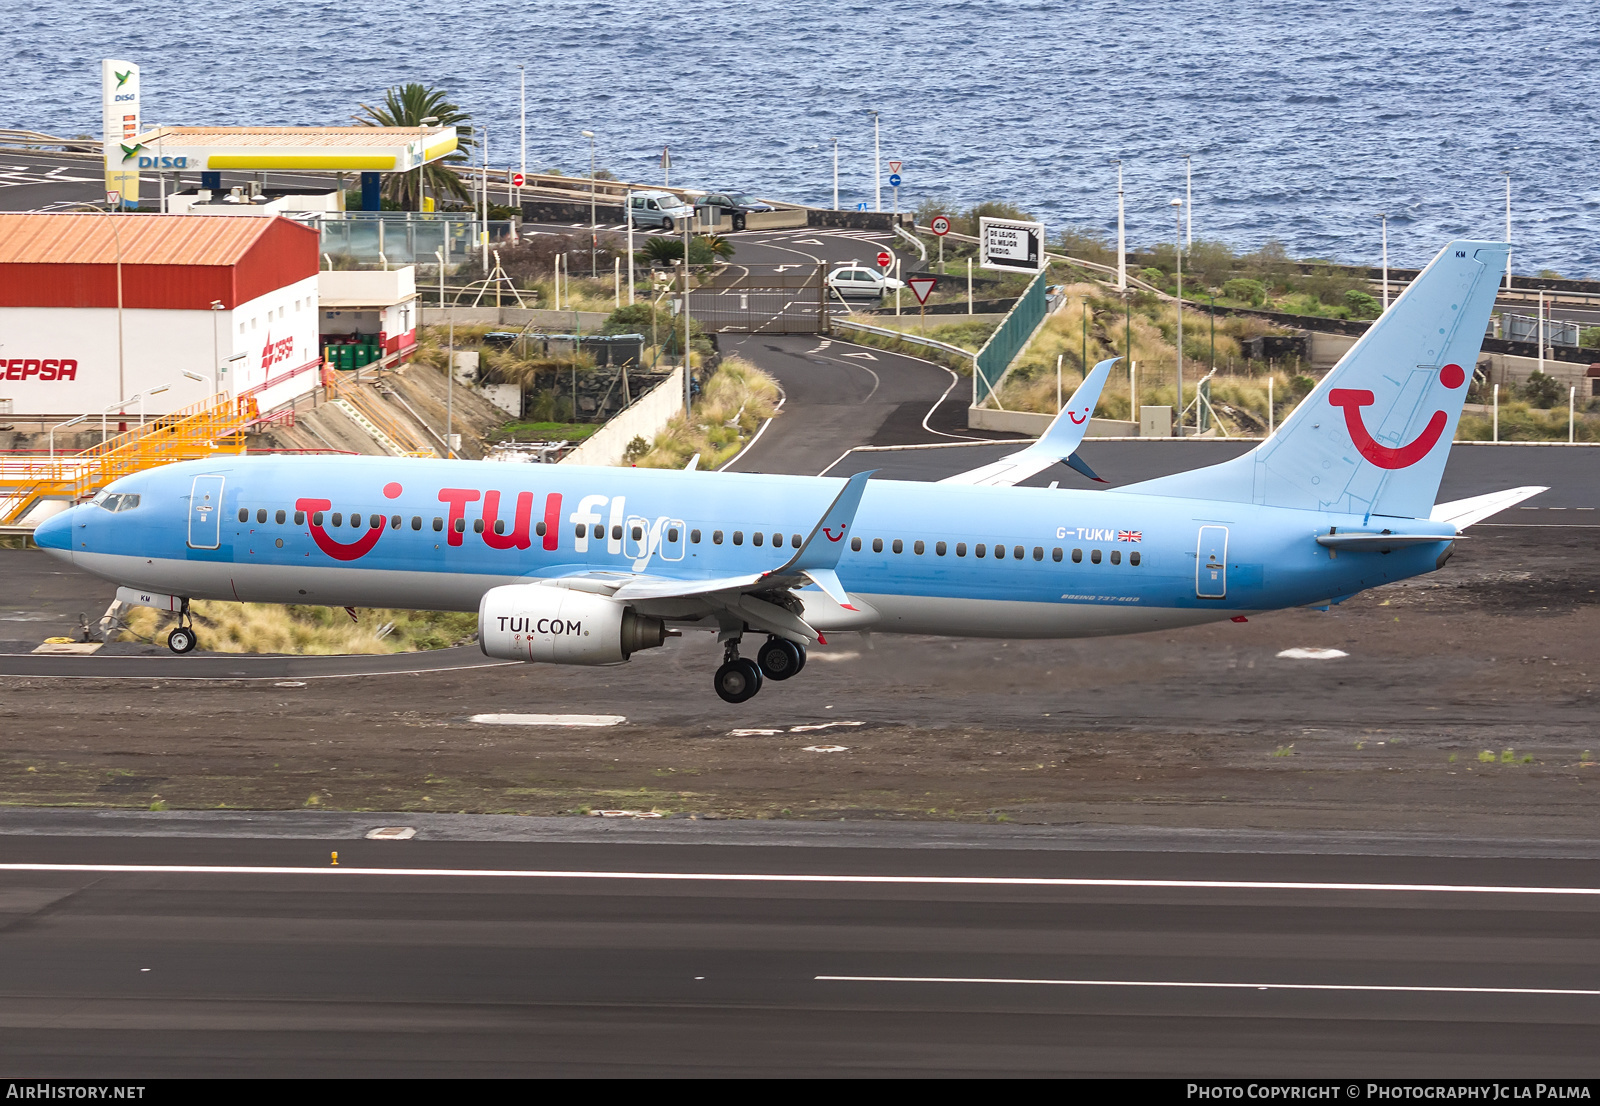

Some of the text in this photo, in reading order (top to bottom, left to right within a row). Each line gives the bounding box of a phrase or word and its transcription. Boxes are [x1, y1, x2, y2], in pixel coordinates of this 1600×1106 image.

[1455, 250, 1466, 258] KM
[438, 487, 671, 573] TUI fly
[1056, 526, 1115, 542] G-TUKM
[140, 594, 151, 603] KM
[497, 616, 582, 636] TUI.COM
